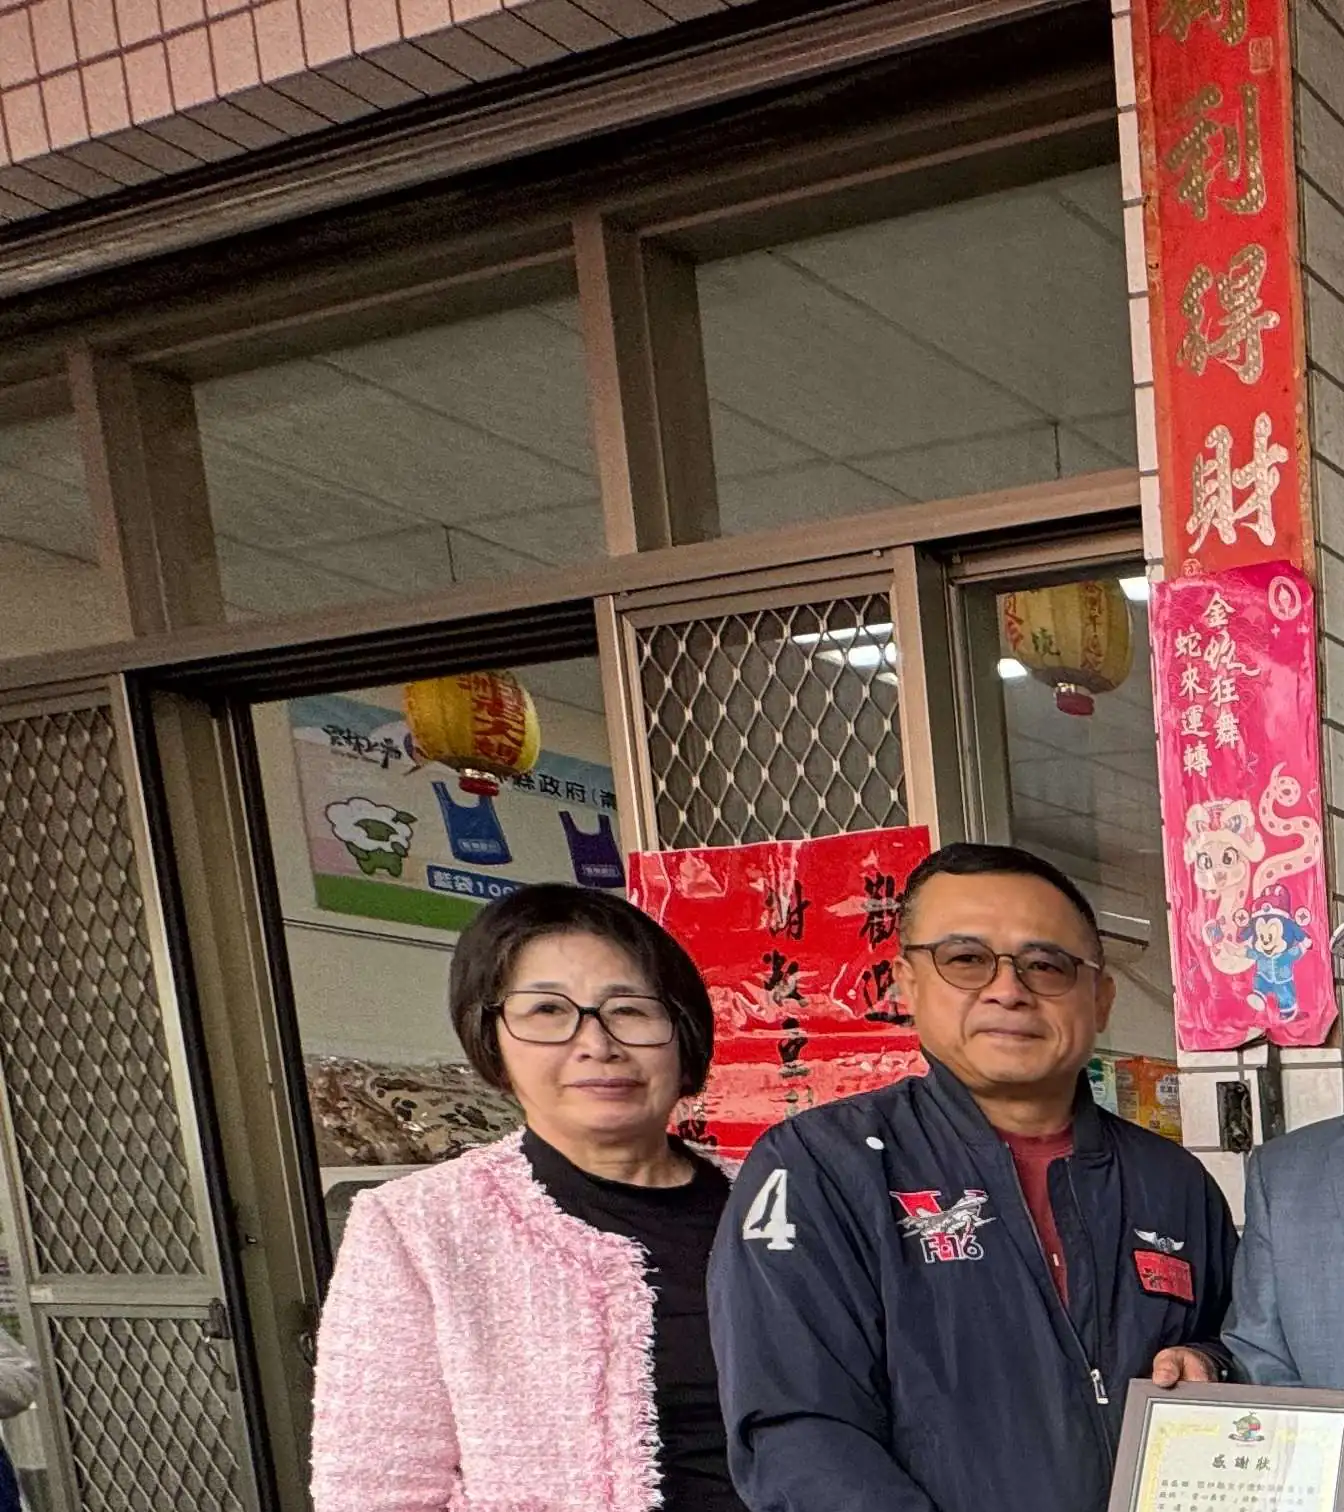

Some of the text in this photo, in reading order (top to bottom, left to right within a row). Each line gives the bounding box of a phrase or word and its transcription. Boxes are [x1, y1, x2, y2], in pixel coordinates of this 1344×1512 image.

[1174, 627, 1212, 777] 蛇來運轉
[742, 1168, 796, 1250] 4
[1211, 1454, 1272, 1472] 感謝狀
